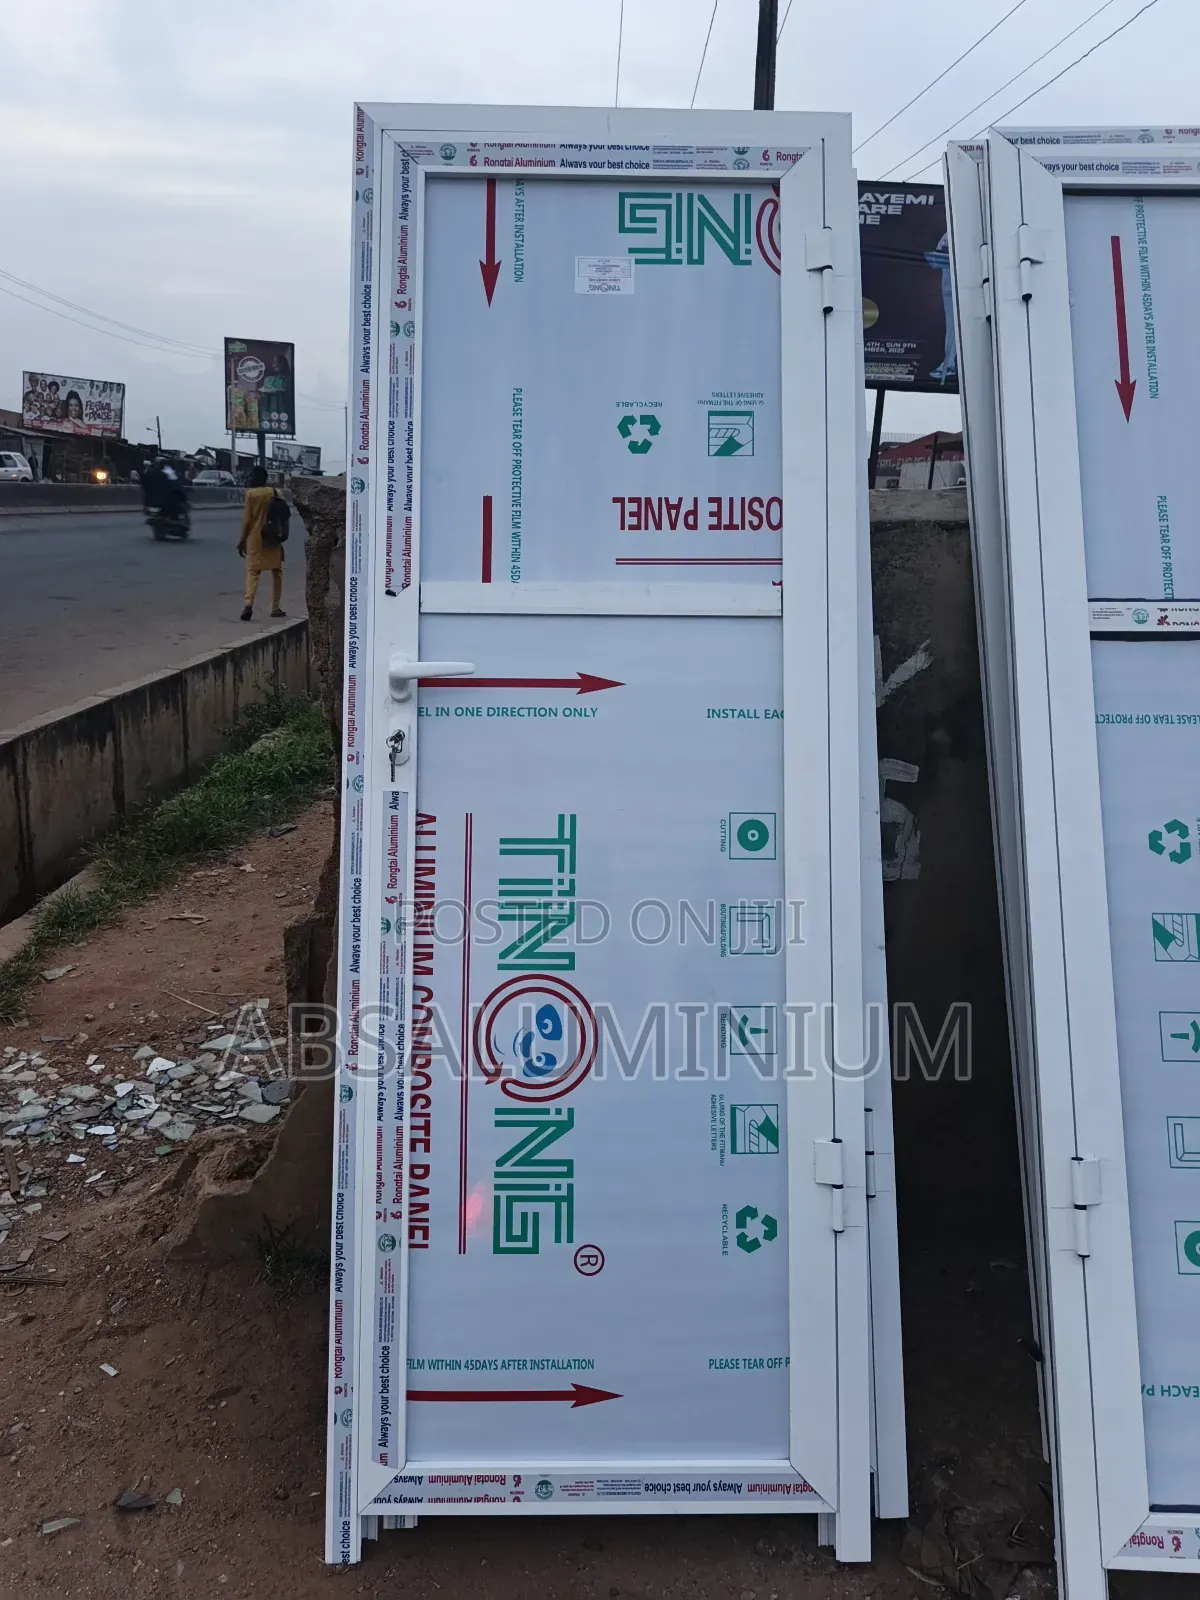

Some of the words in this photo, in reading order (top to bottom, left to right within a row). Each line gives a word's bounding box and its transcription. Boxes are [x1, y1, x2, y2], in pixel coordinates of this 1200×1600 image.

[1037, 136, 1060, 144] choice
[400, 159, 410, 174] best
[484, 157, 513, 167] Rongtai
[515, 157, 555, 167] Aluminium
[610, 159, 624, 168] best
[625, 160, 650, 169] choice
[777, 152, 804, 166] Rongta
[1062, 164, 1077, 172] your
[1079, 162, 1094, 170] best
[1096, 162, 1119, 171] choice
[402, 176, 411, 193] your
[399, 194, 411, 220] Always
[515, 198, 524, 222] AFTER
[1134, 205, 1147, 244] PROTECTIVE
[398, 225, 408, 264] Aluminium
[514, 225, 524, 282] INSTALLATION
[1139, 246, 1148, 262] FILM
[397, 266, 409, 294] Rongtai
[1140, 265, 1150, 291] WITHIN
[361, 284, 371, 309] choice
[1143, 293, 1153, 320] 45DAYS
[361, 310, 371, 326] best
[1145, 322, 1155, 344] AFTER
[360, 346, 370, 373] Always
[1146, 346, 1159, 398] INSTALLATION
[360, 380, 370, 420] Aluminium
[513, 388, 522, 416] PLEASE
[359, 421, 369, 450] Rongtai
[513, 419, 522, 439] TEAR
[512, 442, 522, 457] OFF
[512, 460, 522, 507] PROTECTIVE
[612, 497, 698, 530] PANEL
[1157, 496, 1168, 522] PLEASE
[512, 510, 521, 529] FILM
[402, 517, 412, 557] Aluminium
[1160, 524, 1170, 544] TEAR
[511, 532, 521, 562] WITHIN
[1161, 546, 1171, 560] OFF
[349, 622, 359, 639] your
[436, 707, 449, 716] IN
[454, 707, 482, 717] ONE
[487, 707, 557, 717] DIRECTION
[563, 708, 598, 717] ONLY
[707, 709, 760, 718] INSTALL
[1136, 715, 1151, 724] OFF
[1153, 715, 1175, 724] TEAR
[388, 815, 398, 857] Aluminium
[387, 859, 400, 888] Rongtai
[351, 878, 361, 904] choice
[350, 906, 361, 922] best
[353, 924, 361, 943] your
[350, 944, 361, 973] Always
[396, 1024, 405, 1050] choice
[719, 1013, 727, 1049] BENDING
[393, 1126, 403, 1170] Aluminium
[336, 1242, 346, 1260] your
[379, 1346, 390, 1373] choice
[428, 1359, 461, 1370] WITHIN
[464, 1359, 498, 1370] 45DAYS
[501, 1359, 528, 1370] AFTER
[530, 1359, 594, 1370] INSTALLATION
[709, 1359, 740, 1369] PLEASE
[742, 1358, 764, 1369] TEAR
[767, 1358, 783, 1368] OFF
[379, 1376, 389, 1393] best
[1161, 1385, 1199, 1398] EACH
[381, 1396, 391, 1415] your
[378, 1417, 391, 1448] Always
[429, 1475, 473, 1486] Aluminium
[645, 1483, 671, 1494] choice
[673, 1483, 690, 1494] best
[692, 1480, 711, 1491] your
[713, 1481, 743, 1494] Always
[748, 1484, 791, 1494] Aluminium
[340, 1521, 350, 1549] choice
[1129, 1531, 1164, 1549] Rongtai
